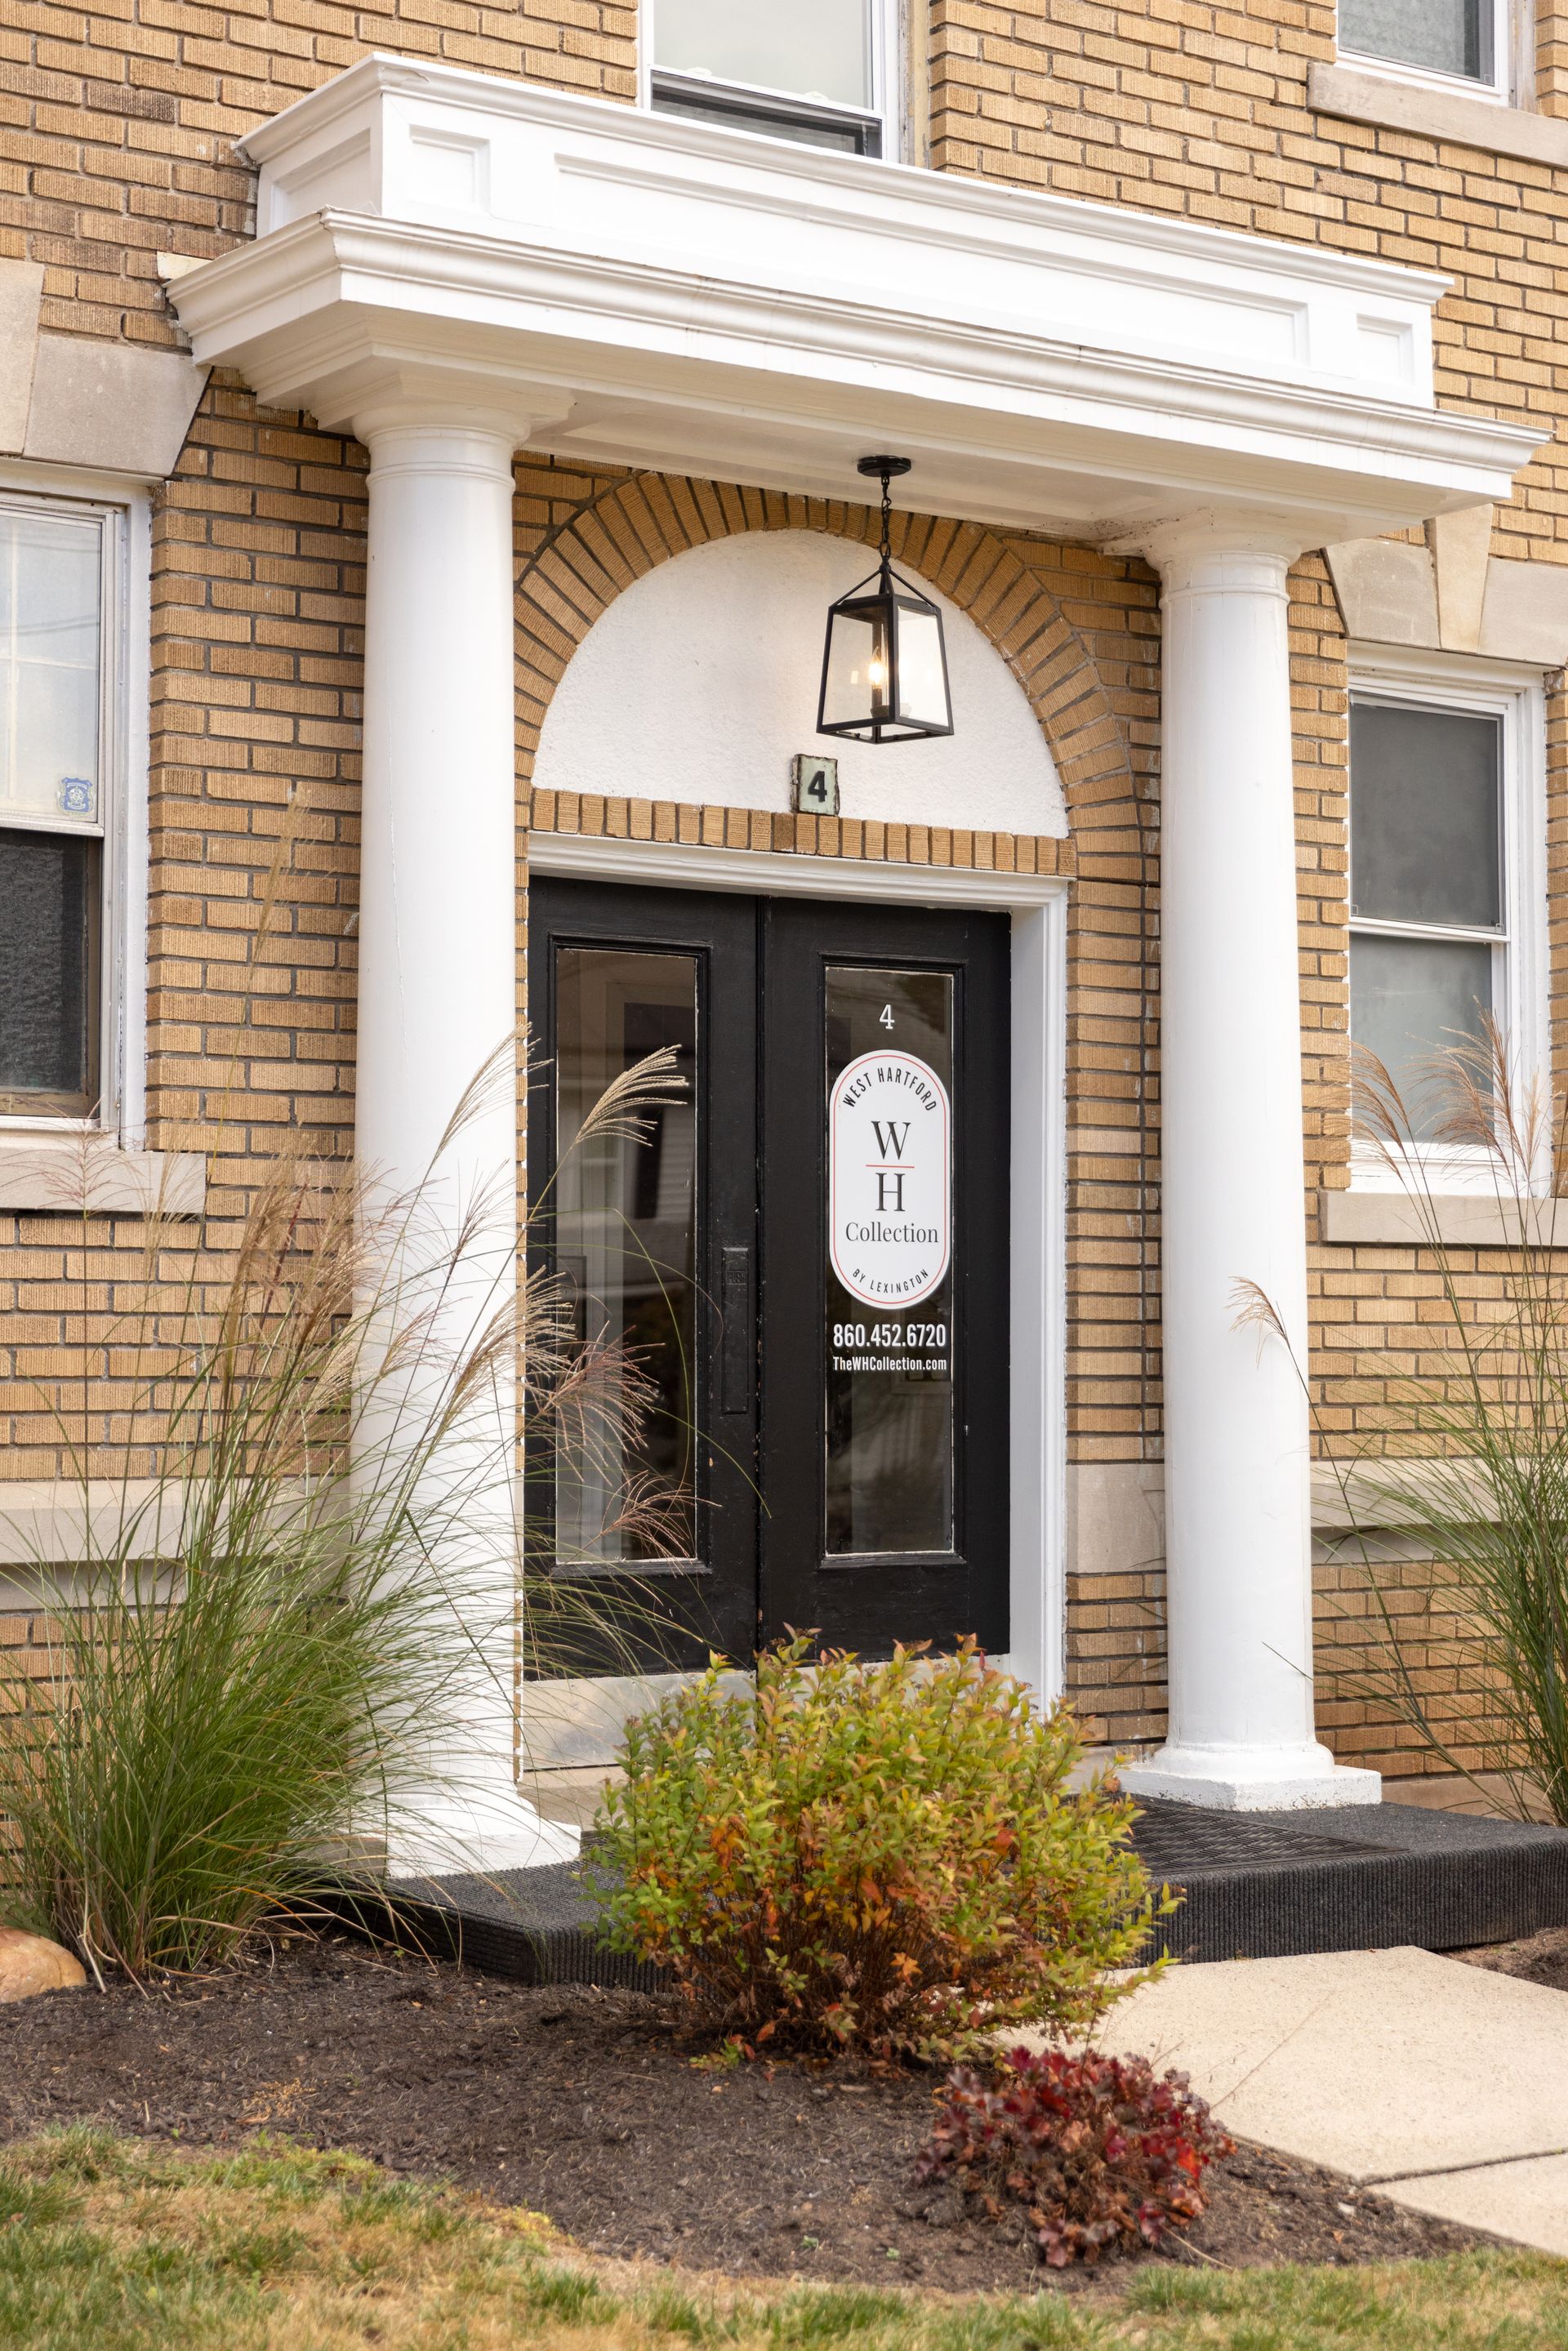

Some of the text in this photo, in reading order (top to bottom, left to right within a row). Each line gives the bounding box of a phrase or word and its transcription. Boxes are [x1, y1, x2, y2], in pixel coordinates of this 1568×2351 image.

[808, 771, 827, 803] 4
[879, 1004, 895, 1030] 4
[843, 1066, 937, 1111] WEST HARTFORD
[871, 1120, 911, 1160] W
[875, 1173, 905, 1212] H
[845, 1222, 938, 1243] Collection
[853, 1268, 929, 1293] BY LEXINGTON
[833, 1324, 946, 1347] 860.452.6720
[833, 1356, 947, 1371] TheWHCollection.com
